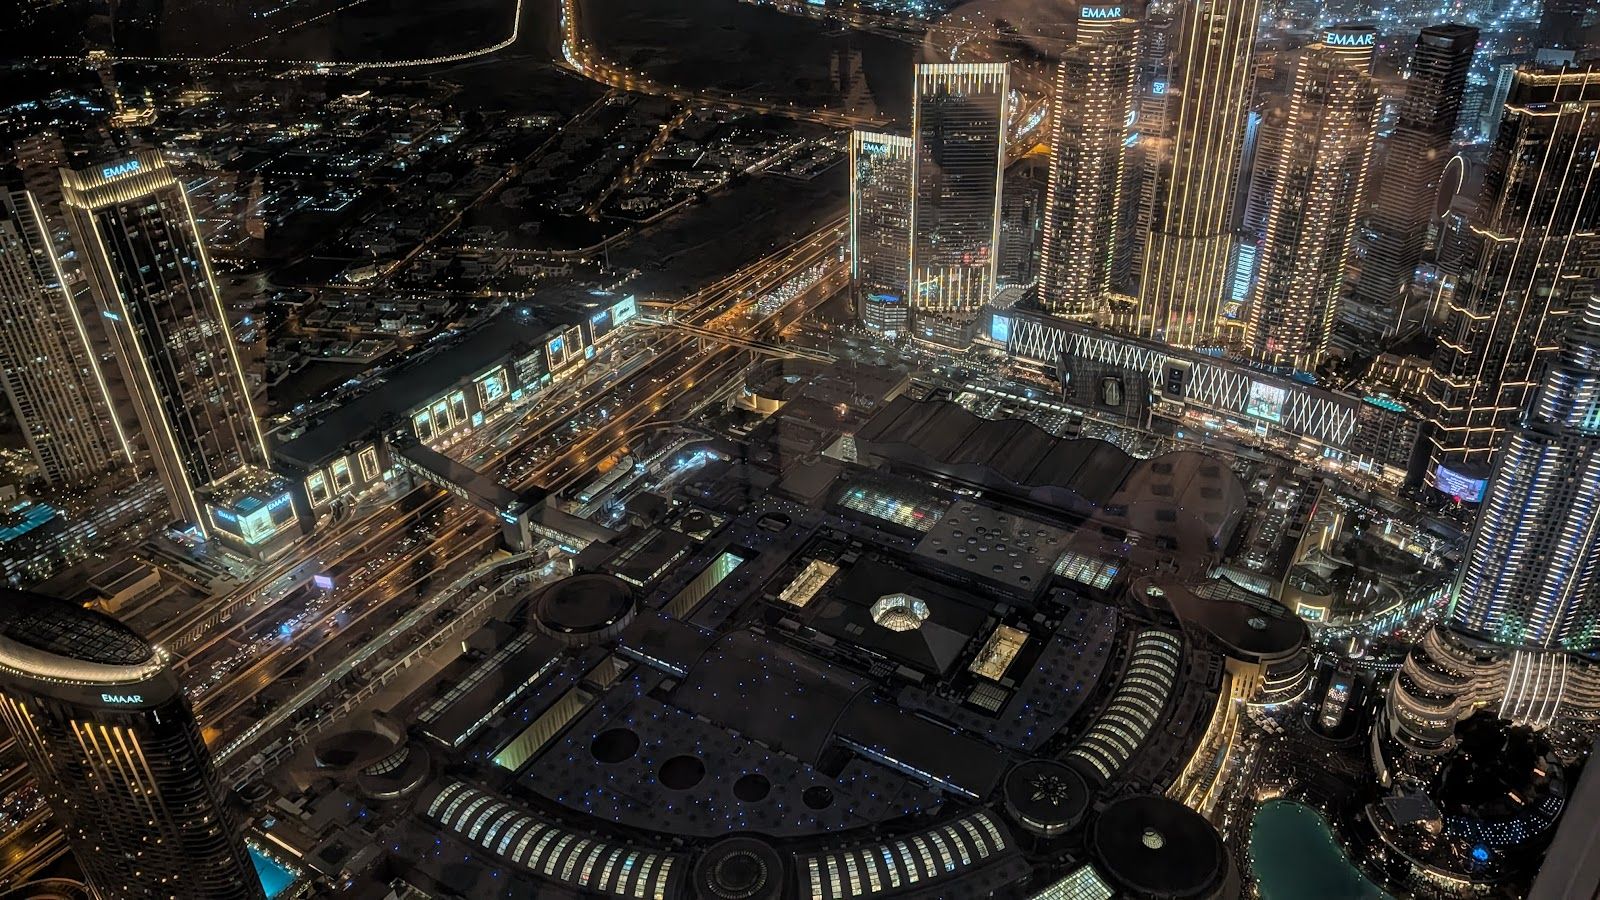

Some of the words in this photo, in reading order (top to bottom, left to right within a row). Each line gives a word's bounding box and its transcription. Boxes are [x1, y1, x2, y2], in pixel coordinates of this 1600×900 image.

[1082, 7, 1121, 18] EMAAR
[1327, 32, 1373, 45] EMAAR
[103, 161, 141, 178] EMAAR
[101, 693, 143, 703] EMAAR
